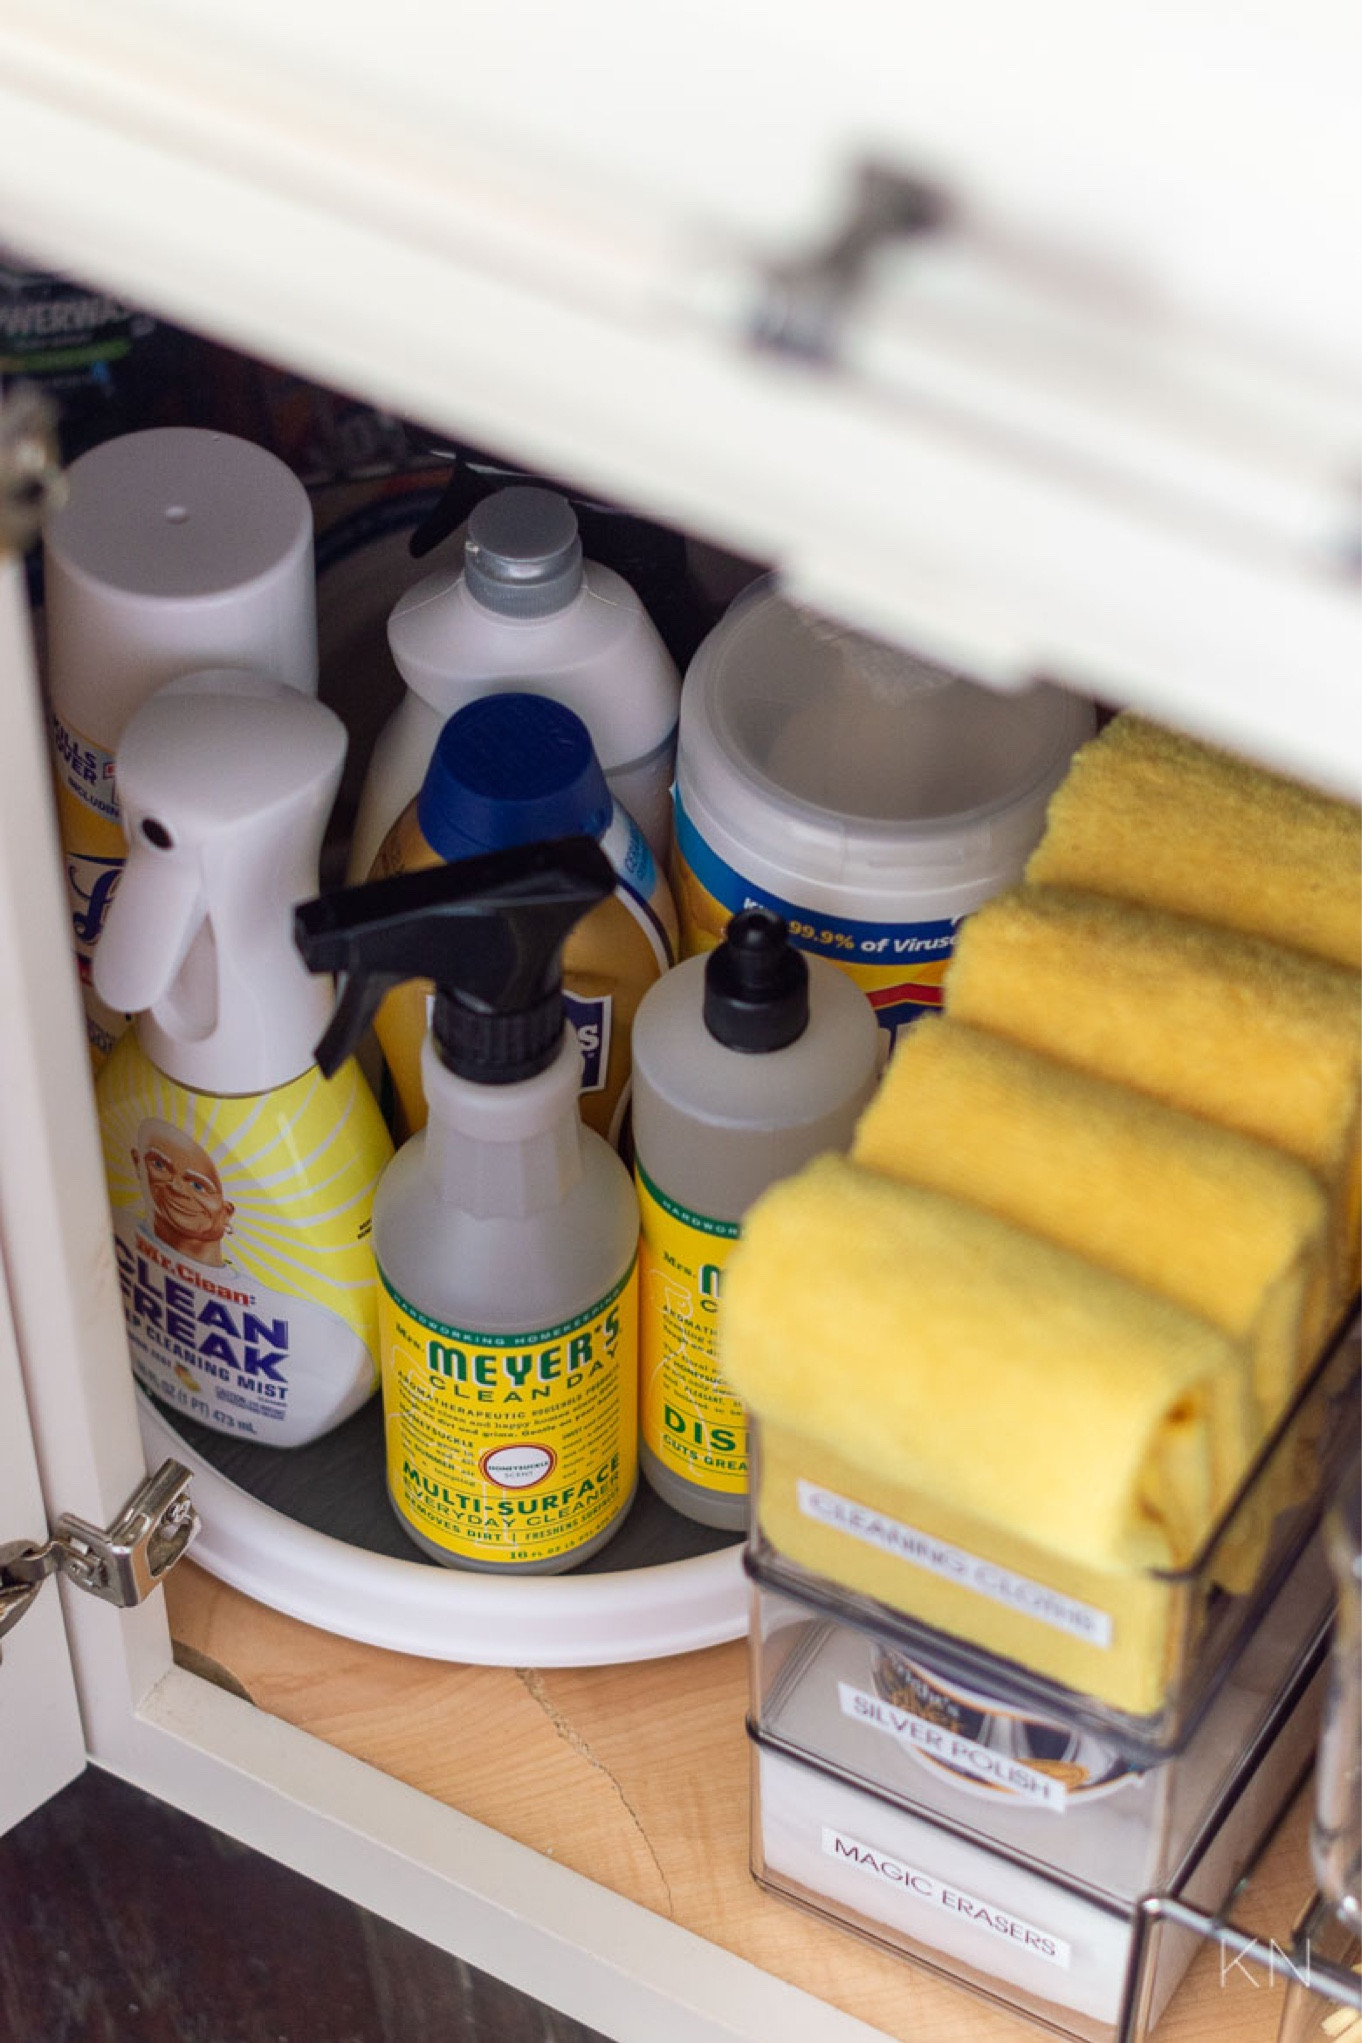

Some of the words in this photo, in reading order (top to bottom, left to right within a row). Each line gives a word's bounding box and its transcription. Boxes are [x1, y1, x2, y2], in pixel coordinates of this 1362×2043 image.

[68, 776, 120, 817] INCLUDIN
[788, 920, 856, 950] 99.9%
[861, 937, 889, 952] of
[662, 1200, 741, 1235] HARDWOR
[176, 1263, 251, 1307] Clean
[146, 1325, 230, 1382] CLEANING
[236, 1374, 289, 1400] MIST
[425, 1304, 619, 1389] MEYER'S
[429, 1375, 551, 1403] CLEAN
[566, 1341, 619, 1389] DAY
[664, 1404, 740, 1452] DIS
[403, 1451, 620, 1517] MULTI-SURFACE
[704, 1455, 748, 1471] GREA
[403, 1475, 516, 1528] EVERYDAY
[526, 1471, 619, 1527] CLEANER
[467, 1528, 502, 1542] DIRT
[808, 1490, 969, 1576] CLEANING
[852, 1693, 943, 1750] SILVER
[950, 1744, 1051, 1800] POLISH
[834, 1836, 934, 1897] MAGIC
[941, 1889, 1059, 1958] ERASERS
